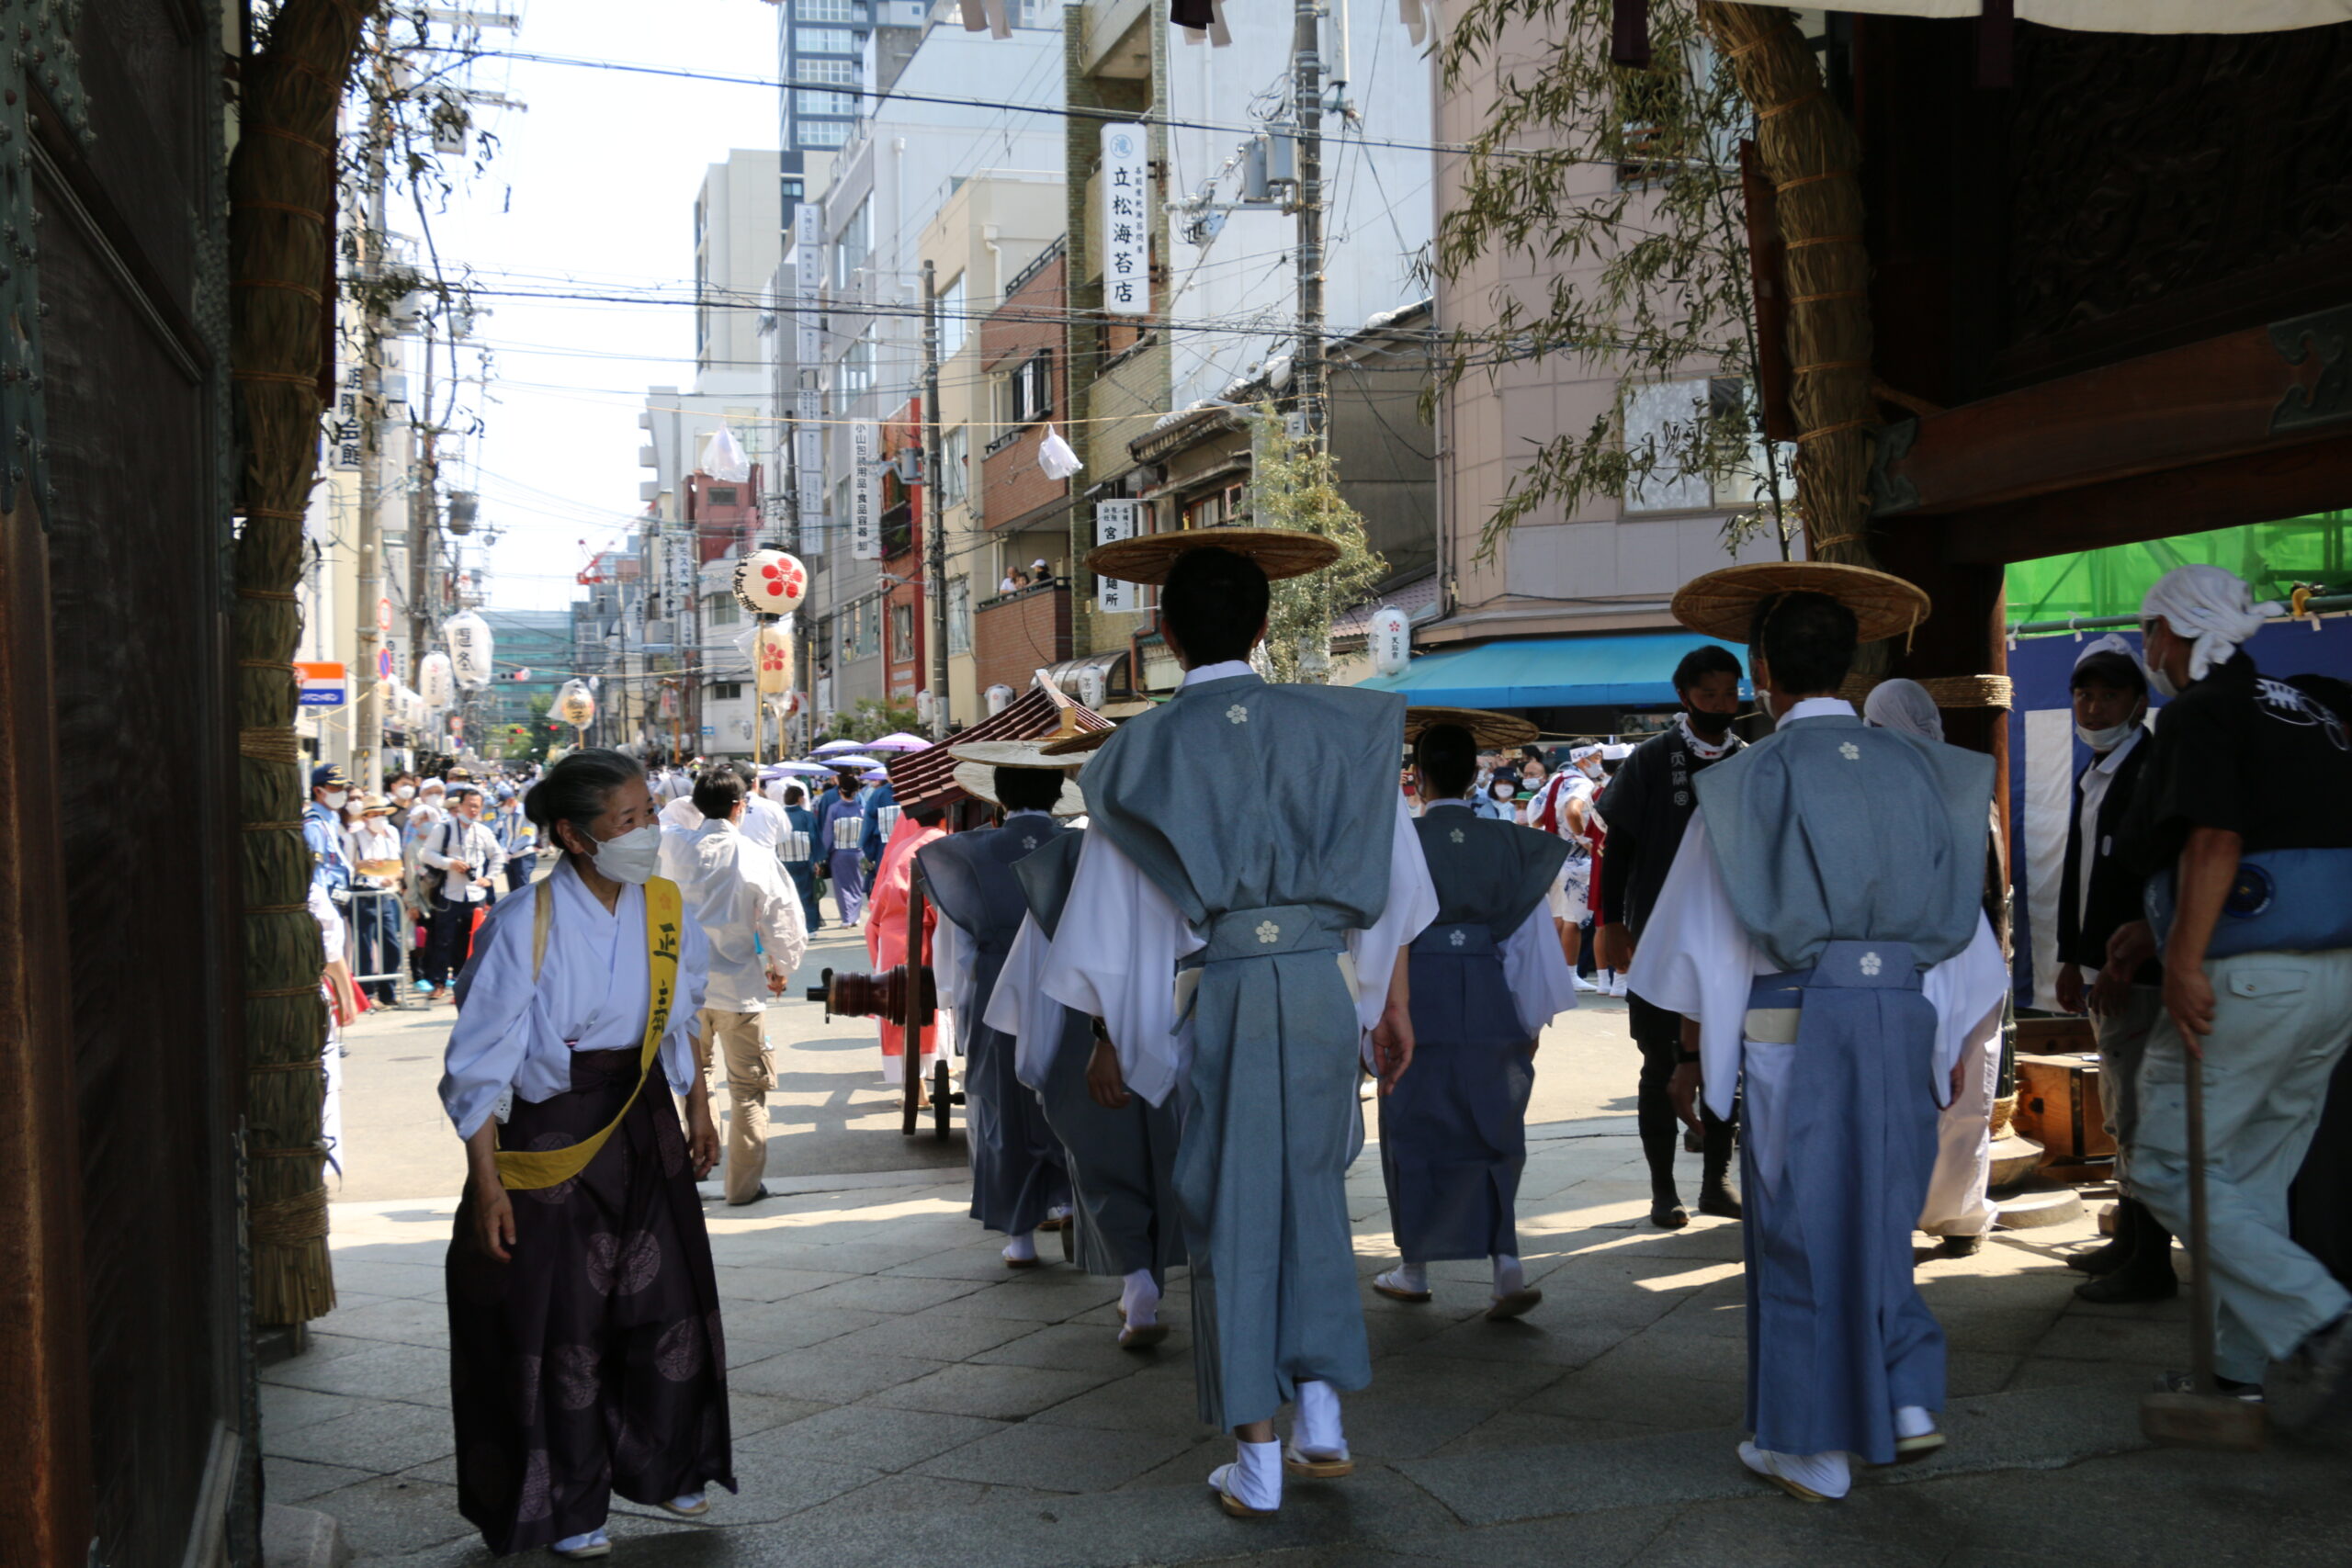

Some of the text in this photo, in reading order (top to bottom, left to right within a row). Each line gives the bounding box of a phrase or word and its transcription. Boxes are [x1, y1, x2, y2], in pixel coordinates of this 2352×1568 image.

[1113, 165, 1133, 303] 立松海苔店
